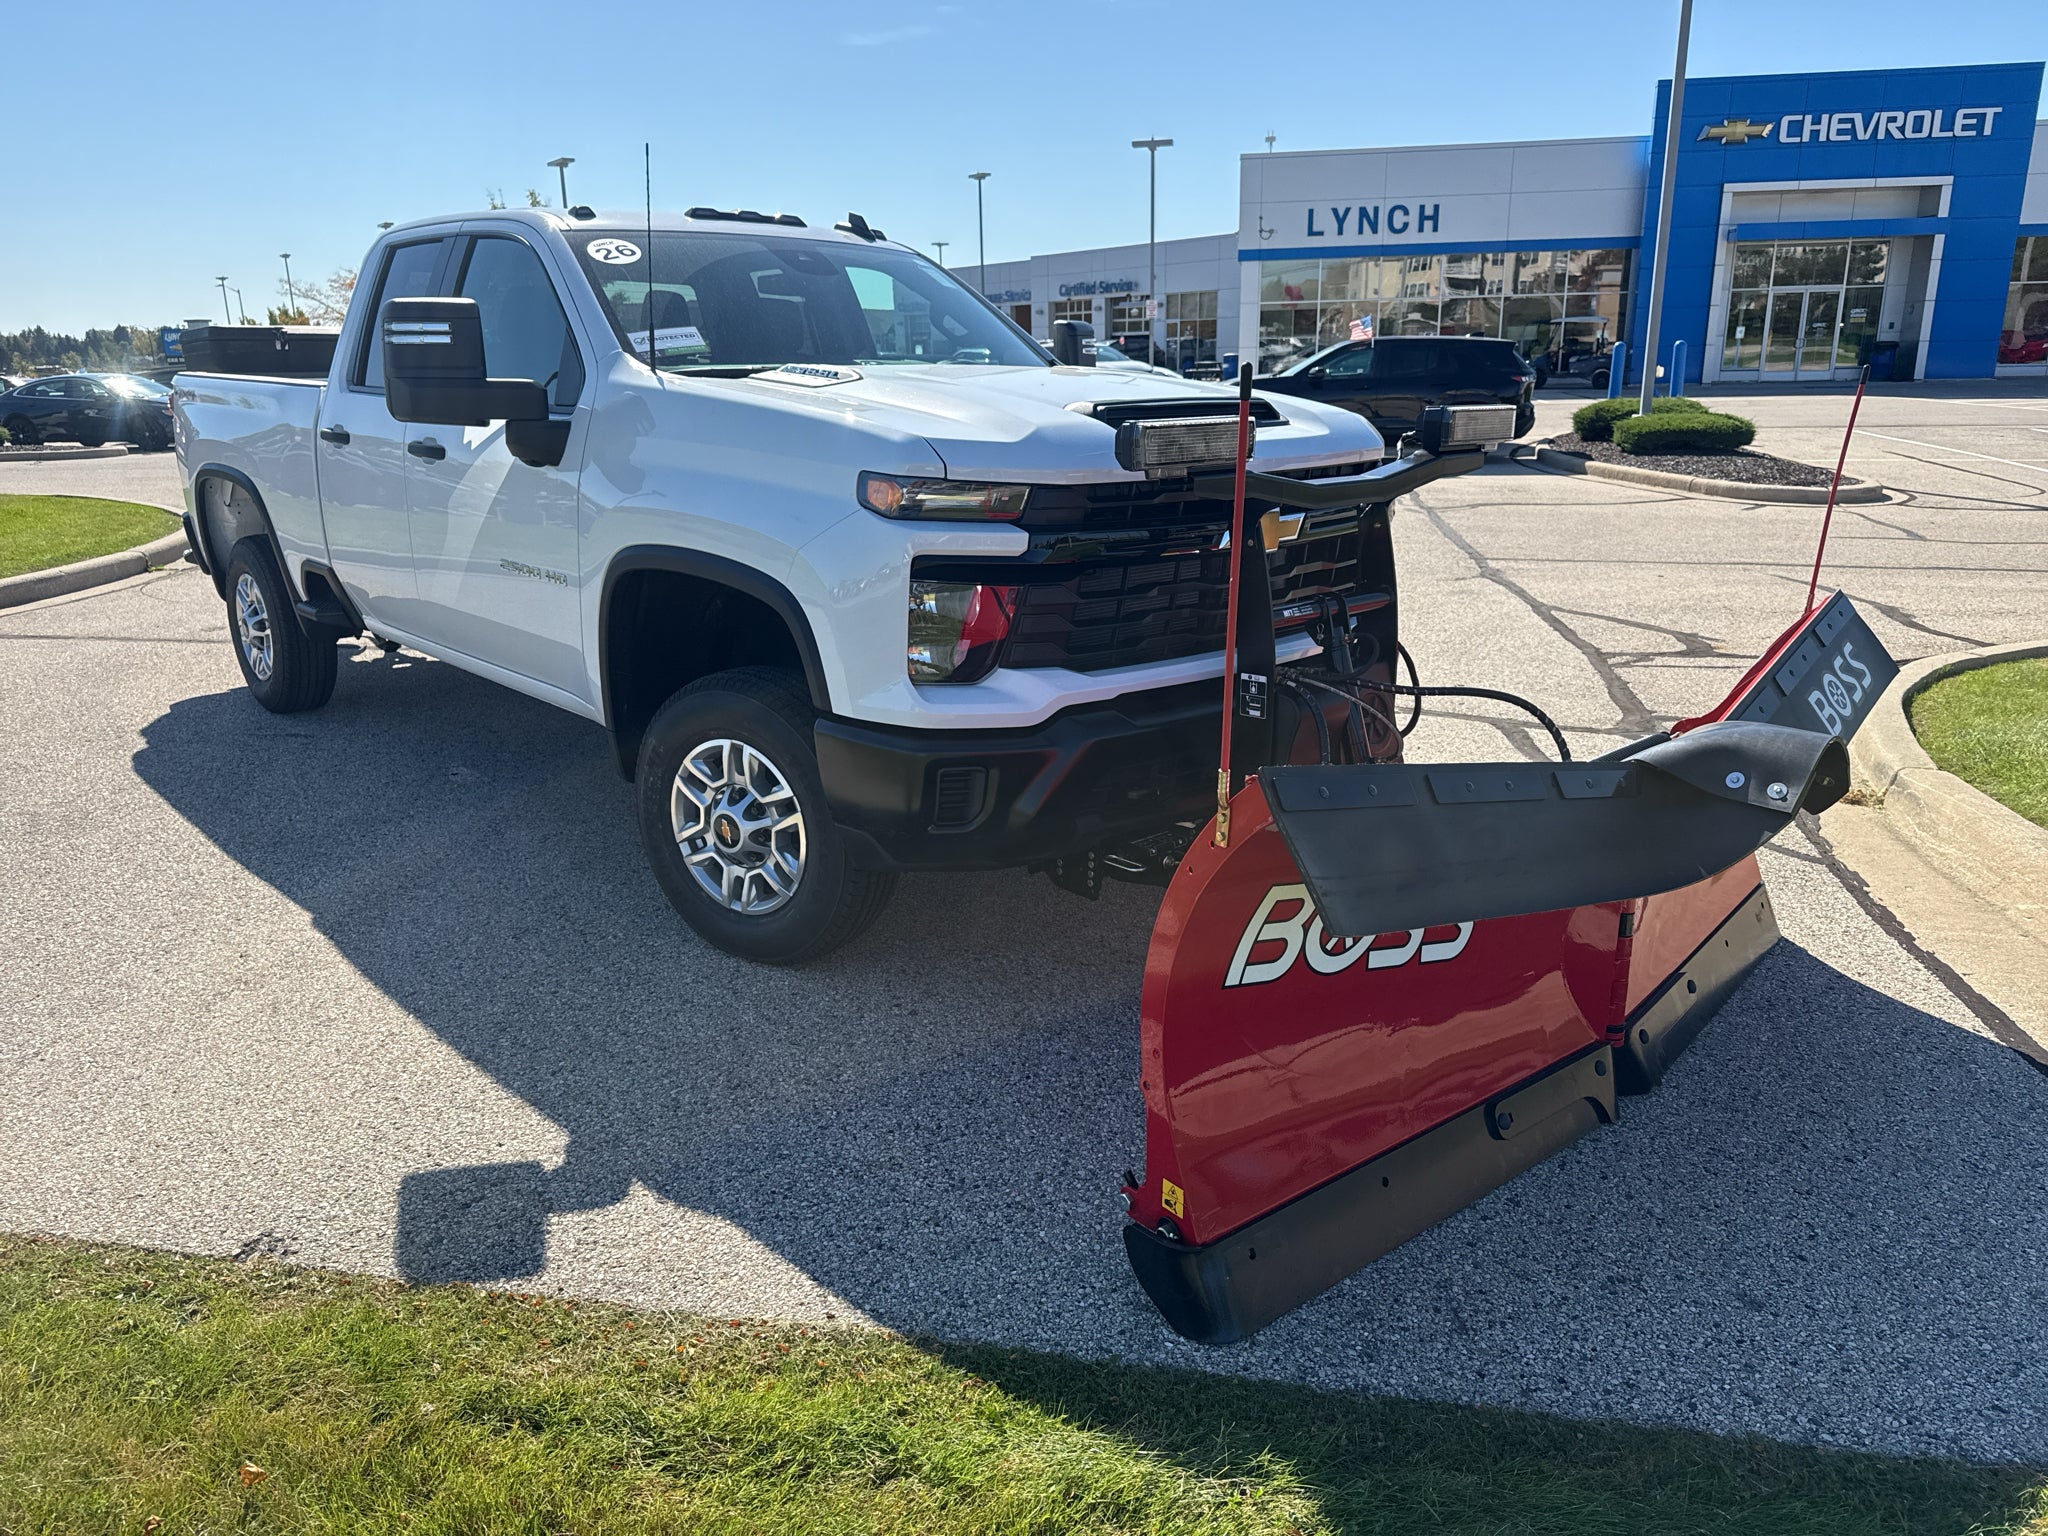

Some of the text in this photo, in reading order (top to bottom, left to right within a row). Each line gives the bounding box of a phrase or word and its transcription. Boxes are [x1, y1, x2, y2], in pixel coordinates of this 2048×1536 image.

[1778, 107, 2003, 143] CHEVROLET
[1307, 203, 1440, 237] LYNCH
[595, 245, 636, 261] 26
[1808, 642, 1871, 736] BOSS
